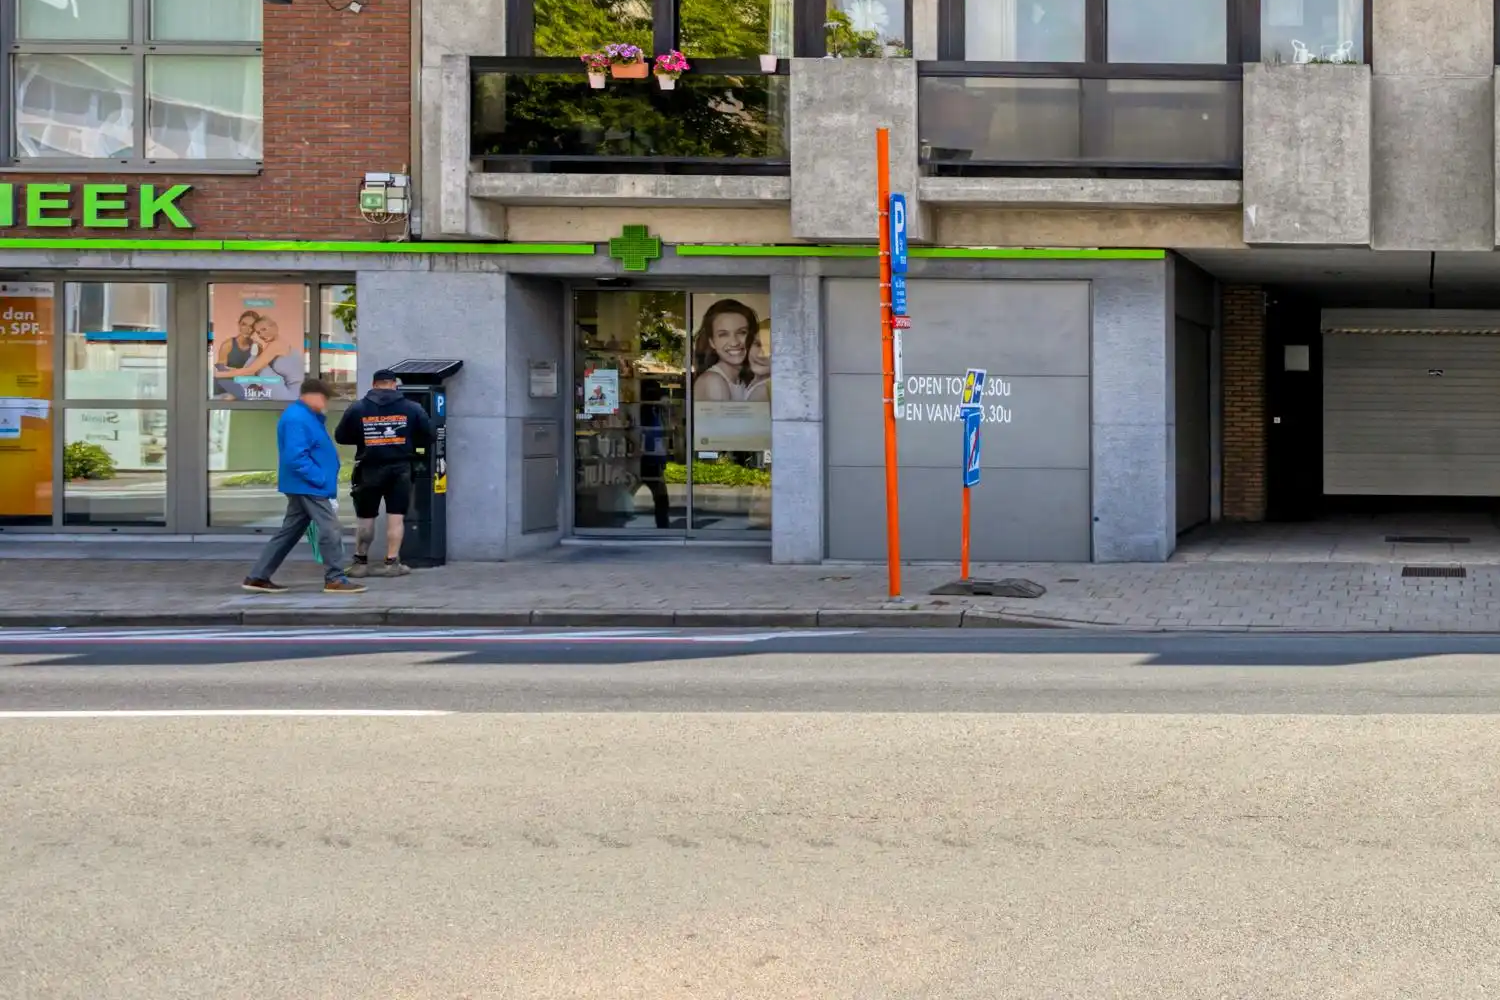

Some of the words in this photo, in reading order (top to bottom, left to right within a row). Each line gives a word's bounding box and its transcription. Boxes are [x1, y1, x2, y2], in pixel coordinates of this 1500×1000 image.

[895, 201, 904, 255] P
[3, 306, 34, 320] dan
[907, 376, 942, 394] OPEN
[946, 377, 966, 395] TO
[437, 395, 444, 413] P
[906, 403, 922, 420] EN
[926, 404, 965, 422] VANA
